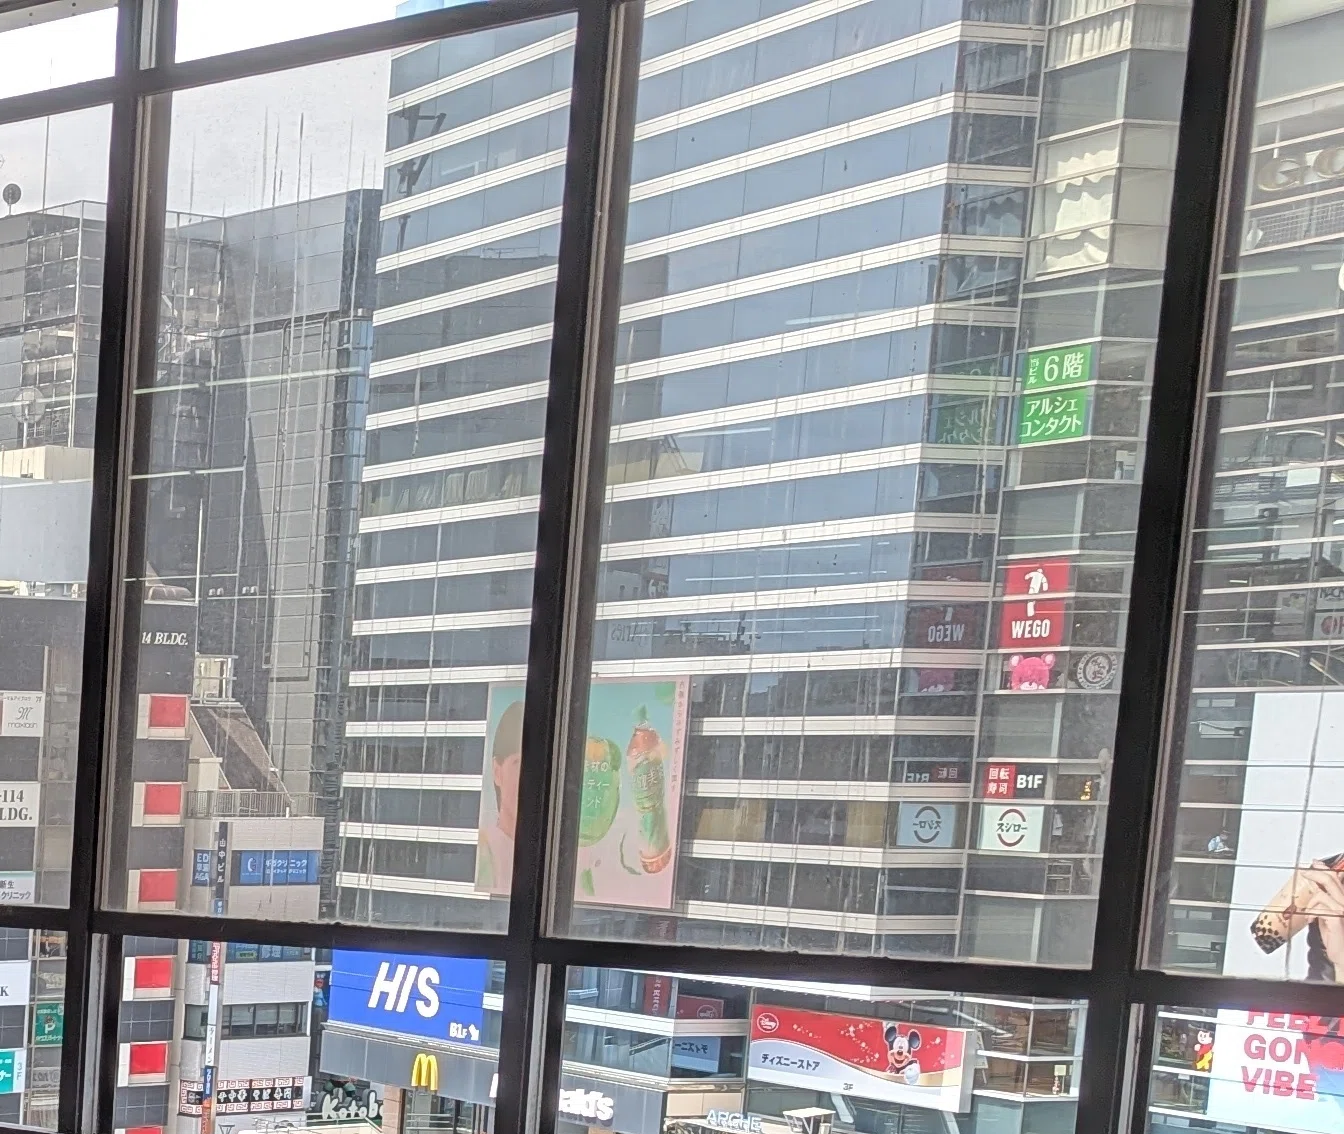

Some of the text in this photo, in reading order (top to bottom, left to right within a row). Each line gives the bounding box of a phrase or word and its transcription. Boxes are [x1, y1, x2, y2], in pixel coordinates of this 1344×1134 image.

[1026, 396, 1078, 418] アルシェ
[1019, 414, 1082, 438] コンタクト
[1011, 619, 1051, 639] WEGO
[153, 631, 189, 646] BLDG.
[988, 767, 1010, 780] 回転
[1016, 774, 1044, 789] B1F
[996, 822, 1028, 834] スシロー
[368, 962, 440, 1018] HIS
[761, 1053, 820, 1071] ディズニーストア
